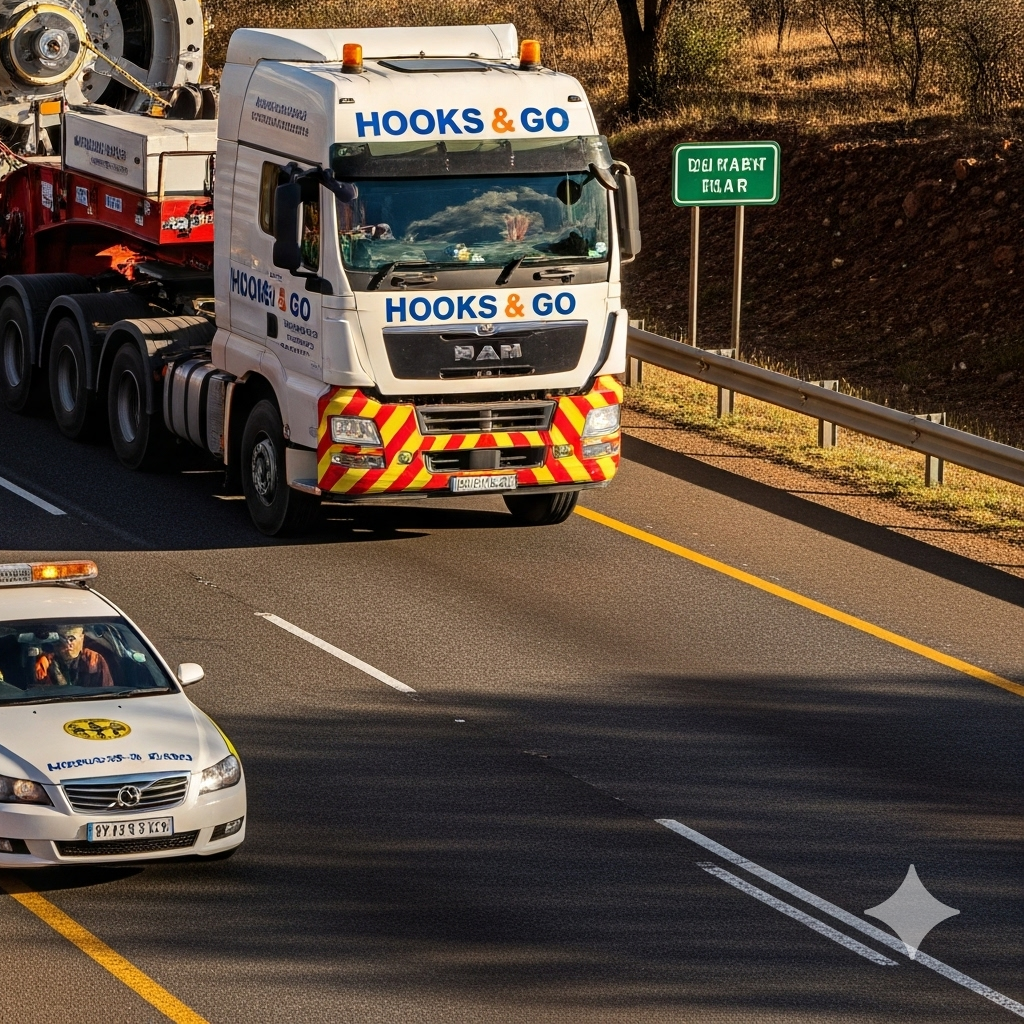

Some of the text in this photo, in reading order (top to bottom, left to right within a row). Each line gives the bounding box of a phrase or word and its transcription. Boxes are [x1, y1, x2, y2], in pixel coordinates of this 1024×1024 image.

[355, 107, 570, 138] HOOKS & GO
[289, 292, 311, 322] GO
[385, 292, 576, 323] HOOKS & GO
